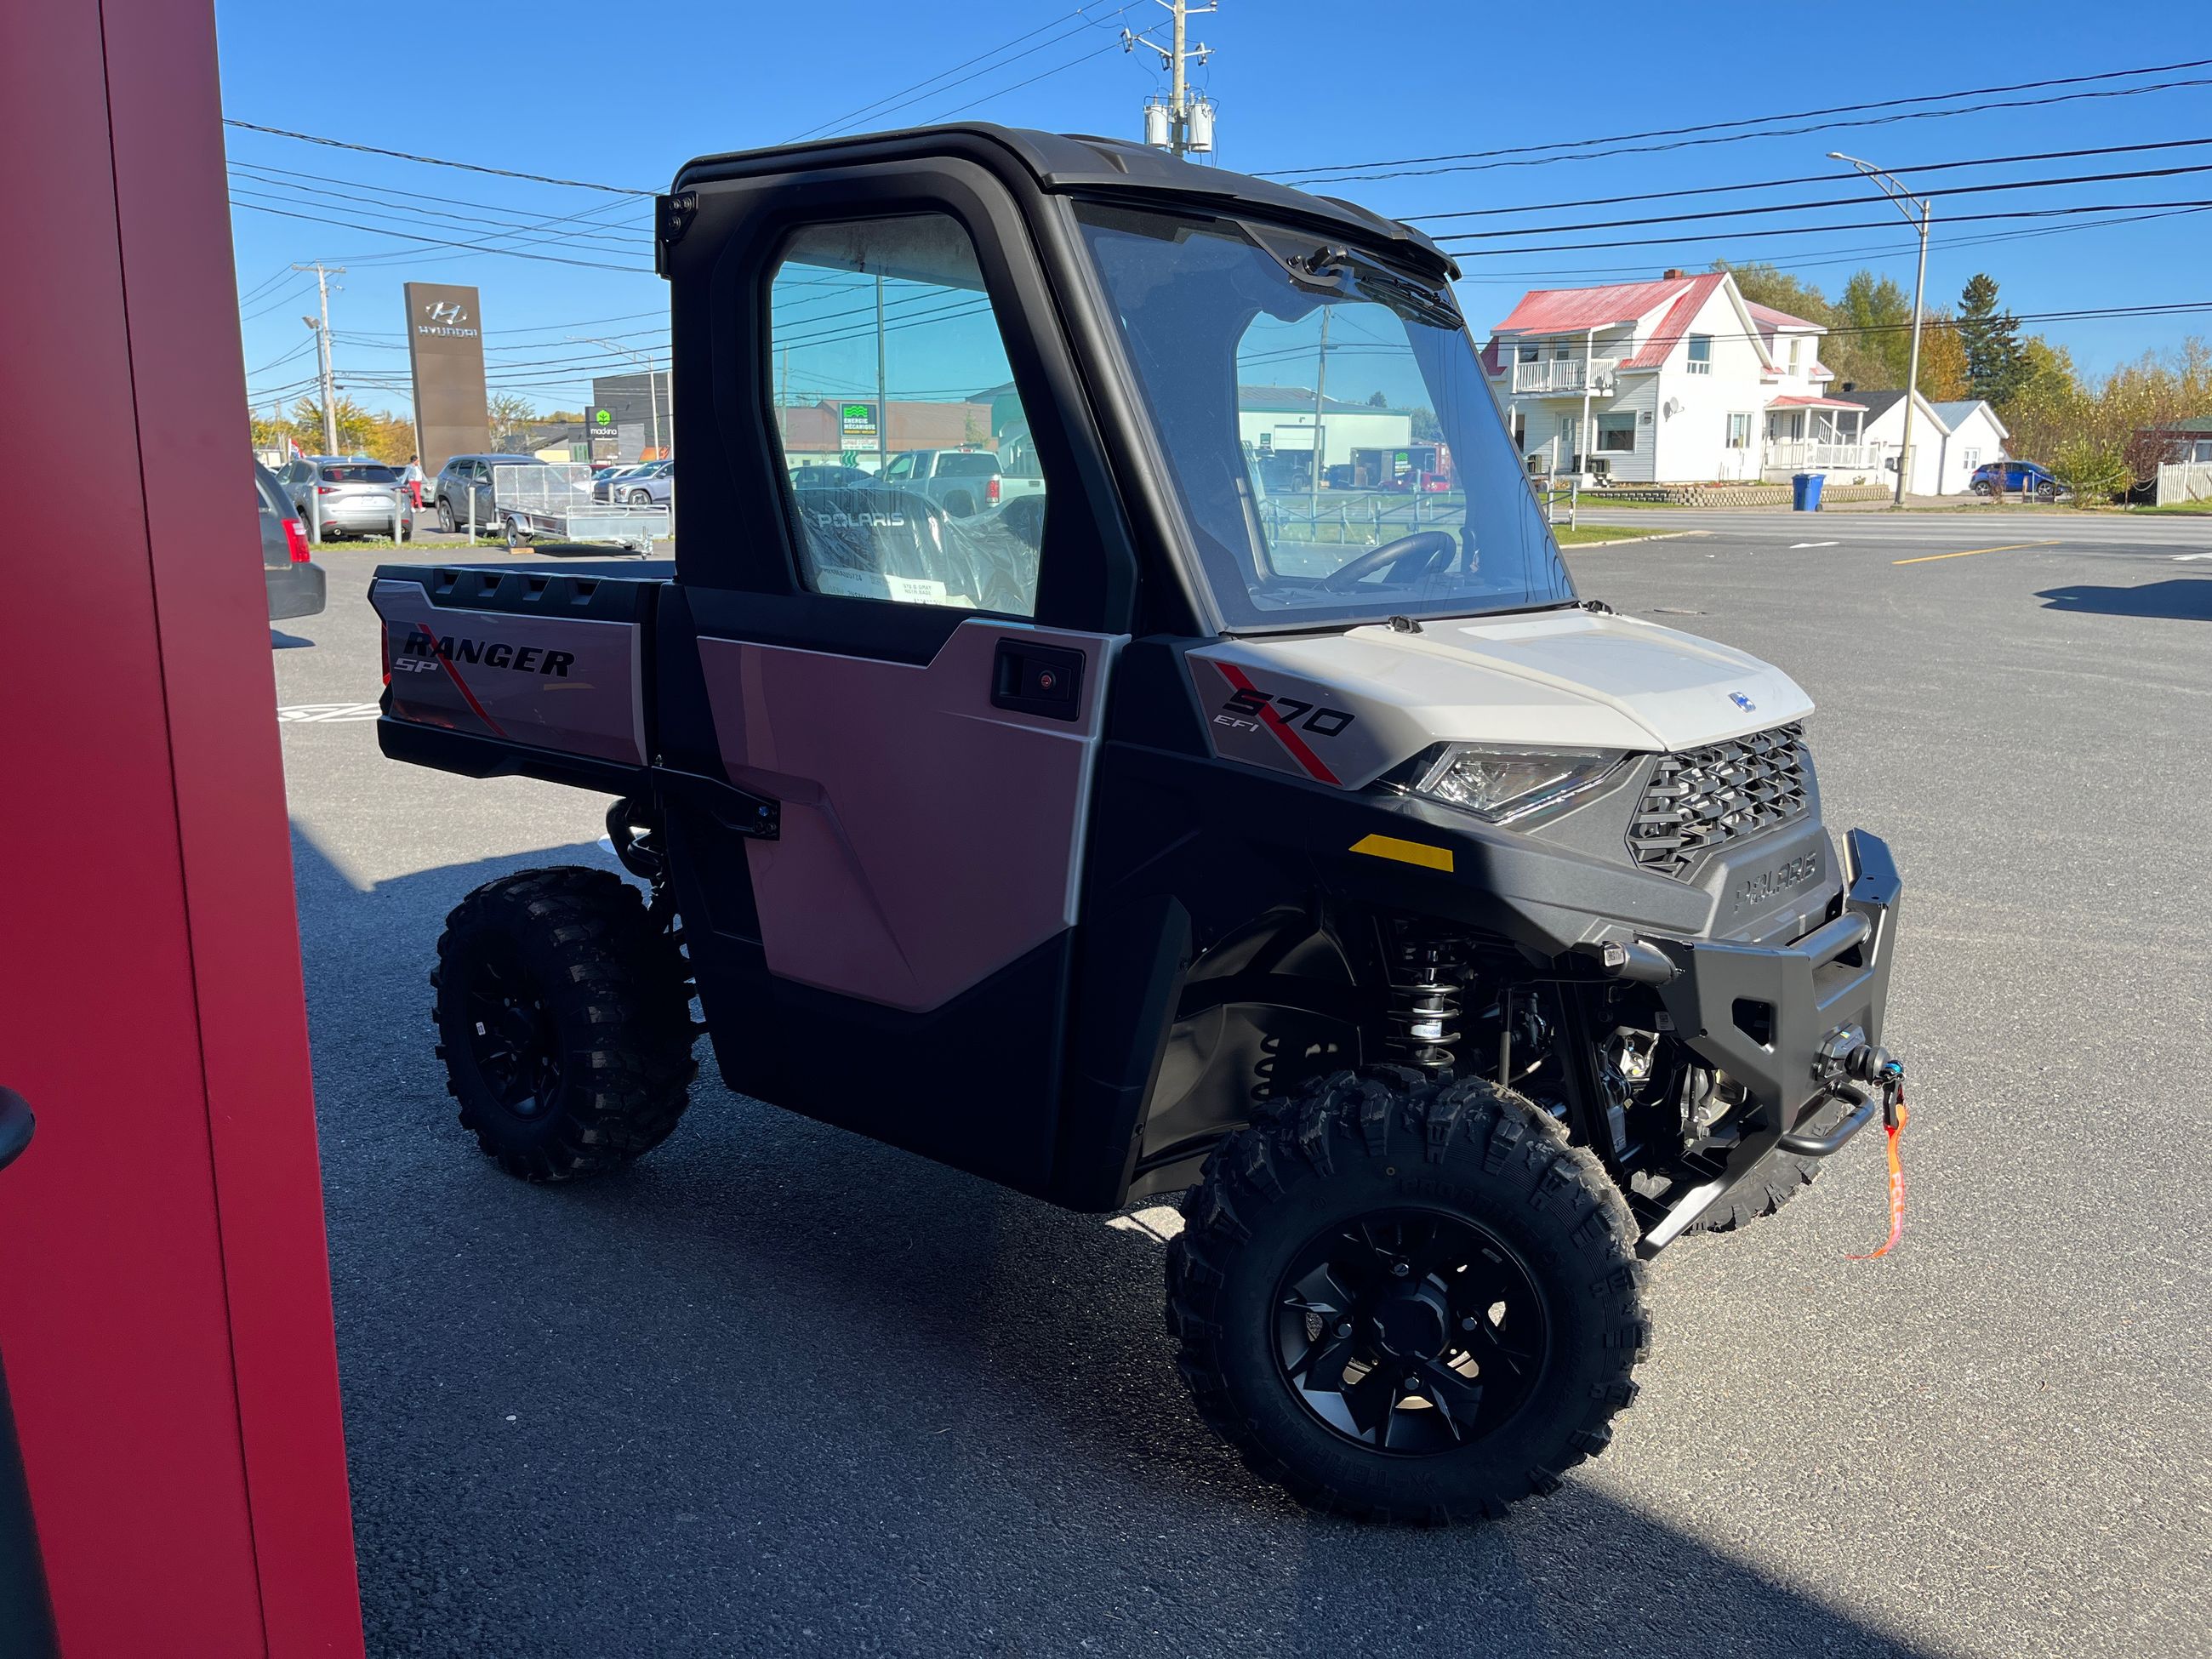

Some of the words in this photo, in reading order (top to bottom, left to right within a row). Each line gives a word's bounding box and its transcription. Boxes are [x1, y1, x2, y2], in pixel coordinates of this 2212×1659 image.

[418, 325, 478, 338] HYUNDAI
[818, 512, 905, 527] POLARIS
[403, 631, 576, 678] RANGER
[393, 657, 439, 673] SP
[1222, 687, 1355, 738] 570
[1213, 715, 1259, 733] EFI
[1733, 851, 1816, 915] POLARIS
